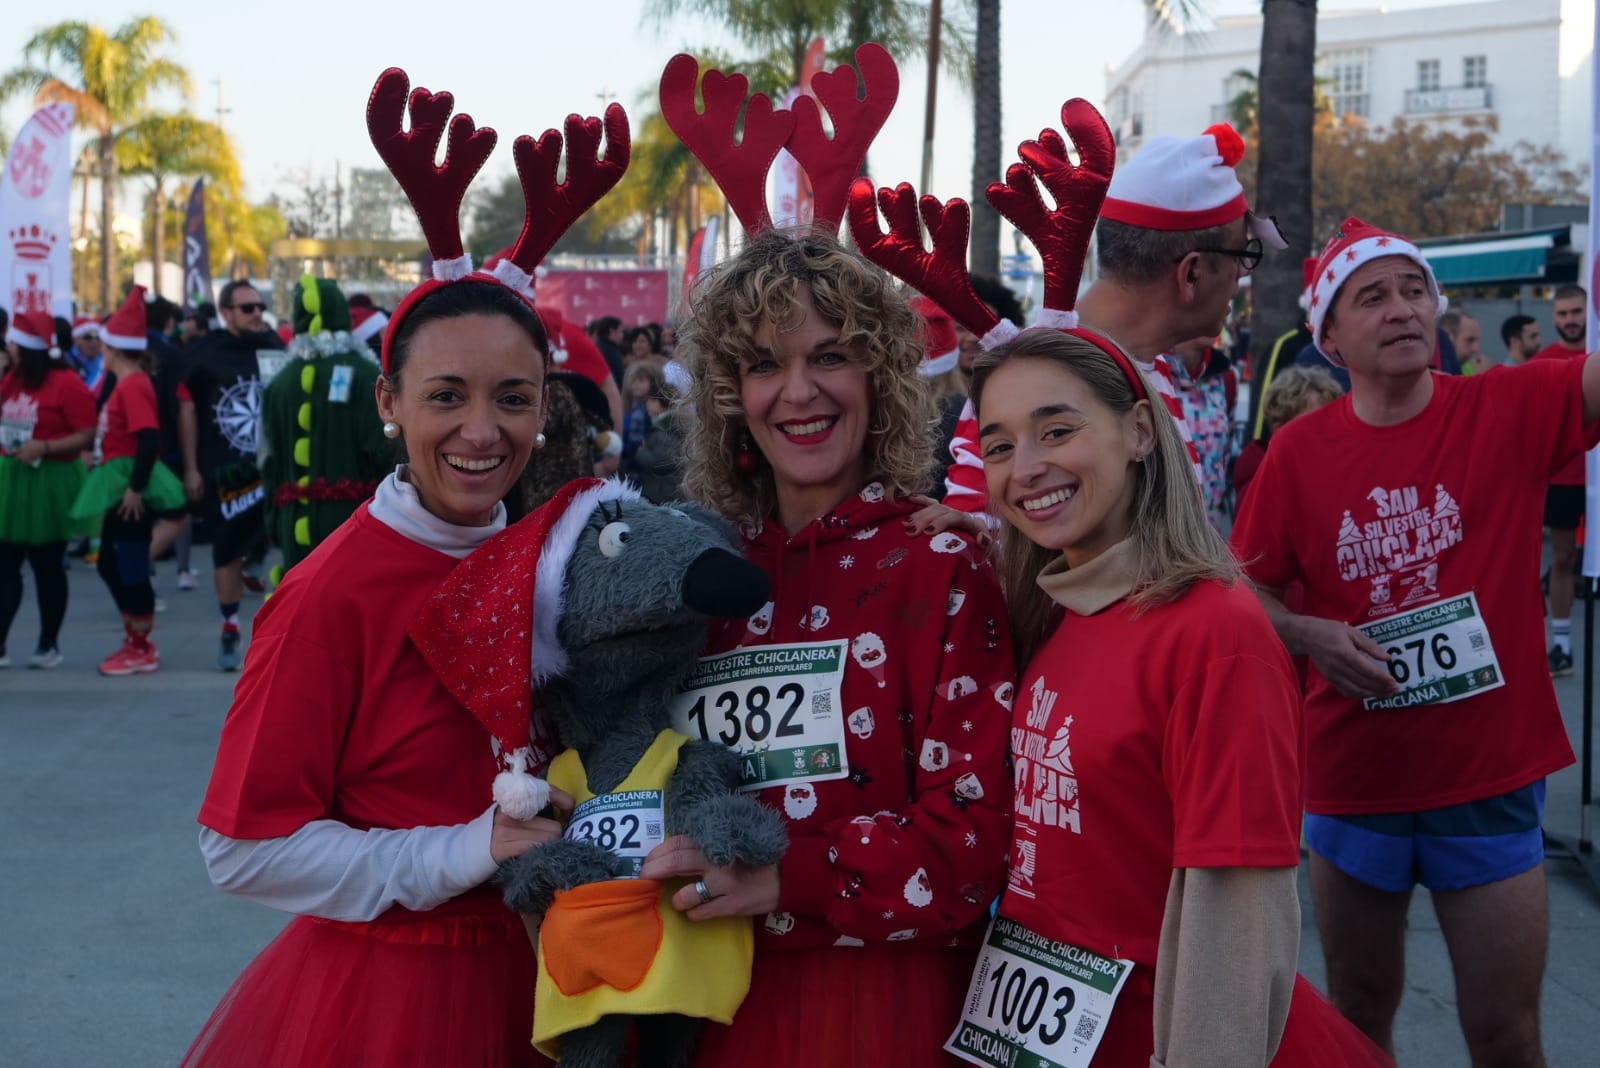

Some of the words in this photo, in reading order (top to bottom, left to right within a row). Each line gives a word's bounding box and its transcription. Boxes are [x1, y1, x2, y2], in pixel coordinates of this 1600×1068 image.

[1376, 486, 1419, 518] SAN
[1364, 507, 1432, 540] SILVESTRE
[1371, 617, 1412, 636] SILVESTRE
[1413, 601, 1470, 623] CHICLANERA
[699, 653, 751, 675] SILVESTRE
[754, 649, 836, 665] CHICLANERA
[713, 671, 731, 683] LOCAL
[732, 669, 740, 678] DE
[742, 665, 774, 676] CARRERAS
[774, 663, 812, 673] POPULARES
[688, 682, 805, 747] 1382
[1026, 689, 1058, 731] SAN
[602, 791, 659, 804] CHICLANERA
[995, 919, 1013, 935] SAN
[1012, 925, 1049, 949] SILVESTRE
[1051, 941, 1118, 978] CHICLANERA
[973, 956, 990, 991] CARMEN
[1061, 961, 1094, 980] POPULARES
[987, 960, 1076, 1045] 1003
[960, 1028, 1011, 1065] CHICLANA
